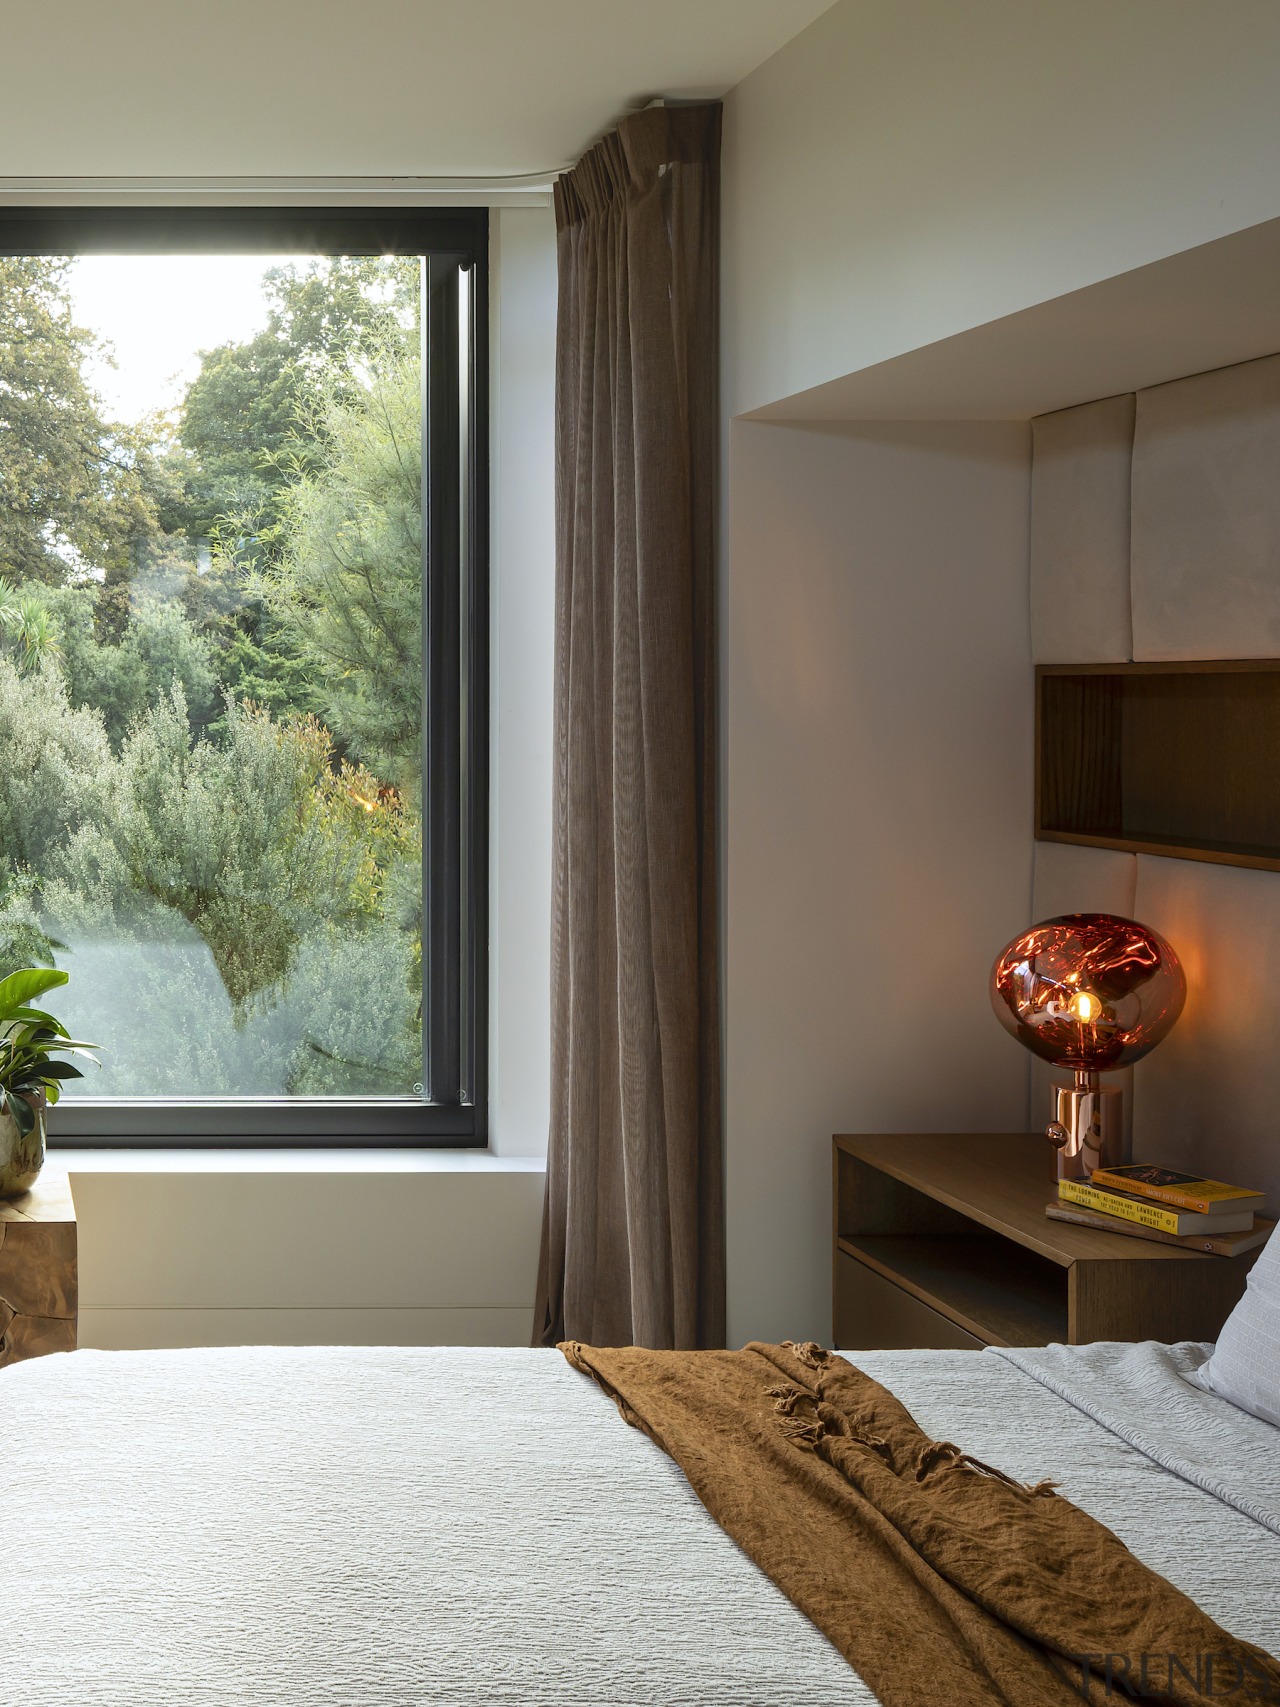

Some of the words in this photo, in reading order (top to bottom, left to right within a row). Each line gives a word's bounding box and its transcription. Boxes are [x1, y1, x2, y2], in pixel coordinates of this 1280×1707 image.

[1068, 1184, 1077, 1193] THE
[1078, 1187, 1100, 1200] LOOMING
[1075, 1194, 1091, 1205] TOWER
[1136, 1205, 1163, 1220] LAWRENCE
[1140, 1215, 1160, 1227] WRIGHT
